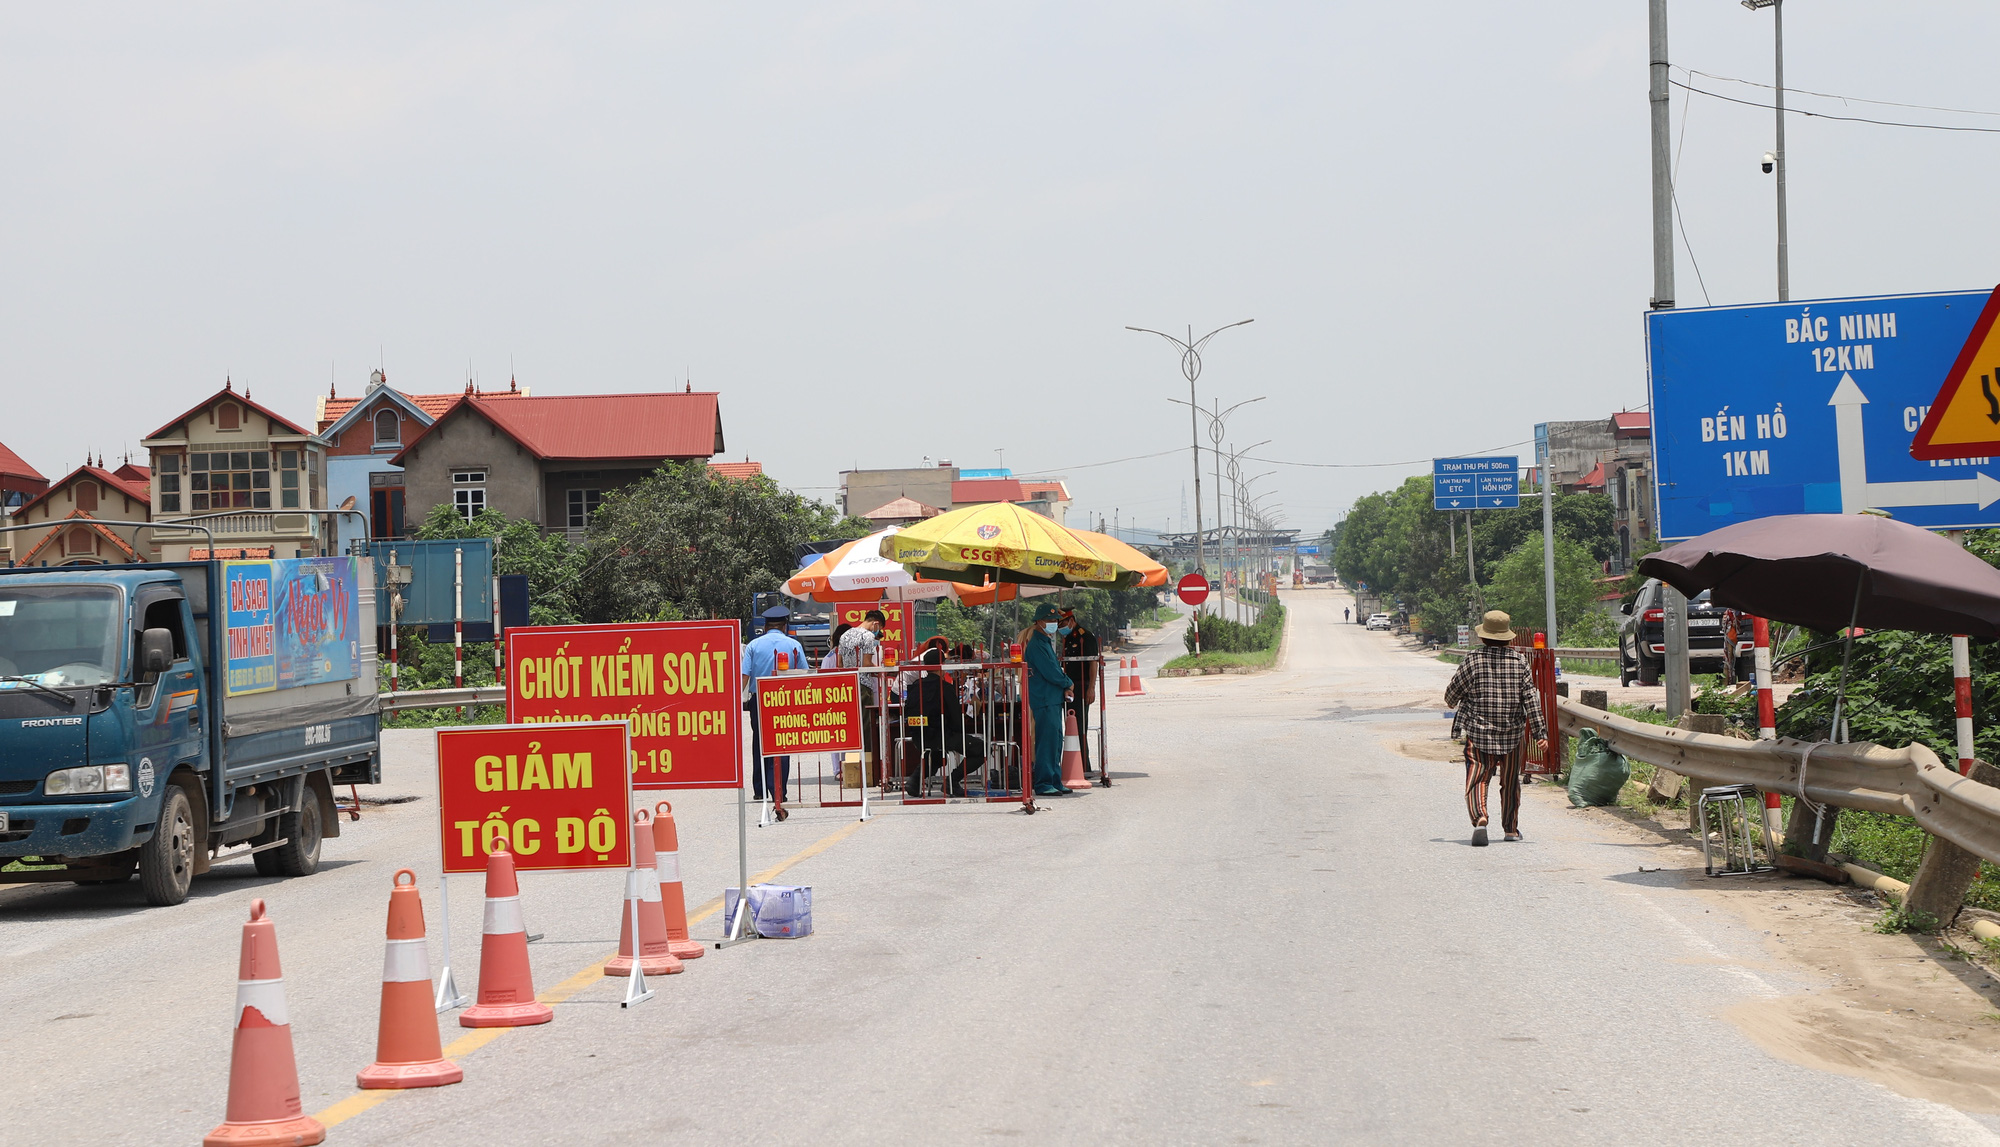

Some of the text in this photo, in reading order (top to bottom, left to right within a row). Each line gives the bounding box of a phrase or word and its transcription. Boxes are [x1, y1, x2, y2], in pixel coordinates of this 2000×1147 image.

[1785, 307, 1897, 344] BẮC NINH
[1811, 344, 1874, 373] 12KM
[1701, 402, 1788, 443] BẾN HỒ
[1442, 463, 1462, 472] TRẠM
[1463, 463, 1476, 471] THU
[1491, 462, 1510, 470] 500m
[1722, 449, 1770, 477] 1KM
[1449, 485, 1464, 493] ETC
[960, 547, 1004, 563] CSGT
[851, 575, 890, 585] 1900 9080
[231, 572, 269, 618] ĐÁ SẠCH
[287, 579, 328, 646] Ngọc
[228, 613, 274, 660] TINH KHIẾT
[519, 636, 727, 700] CHỐT KIỂM SOÁT
[763, 682, 854, 707] CHỐT KIỂM SOÁT
[21, 717, 83, 728] FRONTIER
[677, 710, 727, 741] DỊCH
[773, 707, 847, 729] PHÒNG, CHỐNG
[775, 729, 847, 749] DỊCH COVID-19
[474, 741, 593, 793] GIẢM
[454, 805, 617, 861] TỐC ĐỘ
